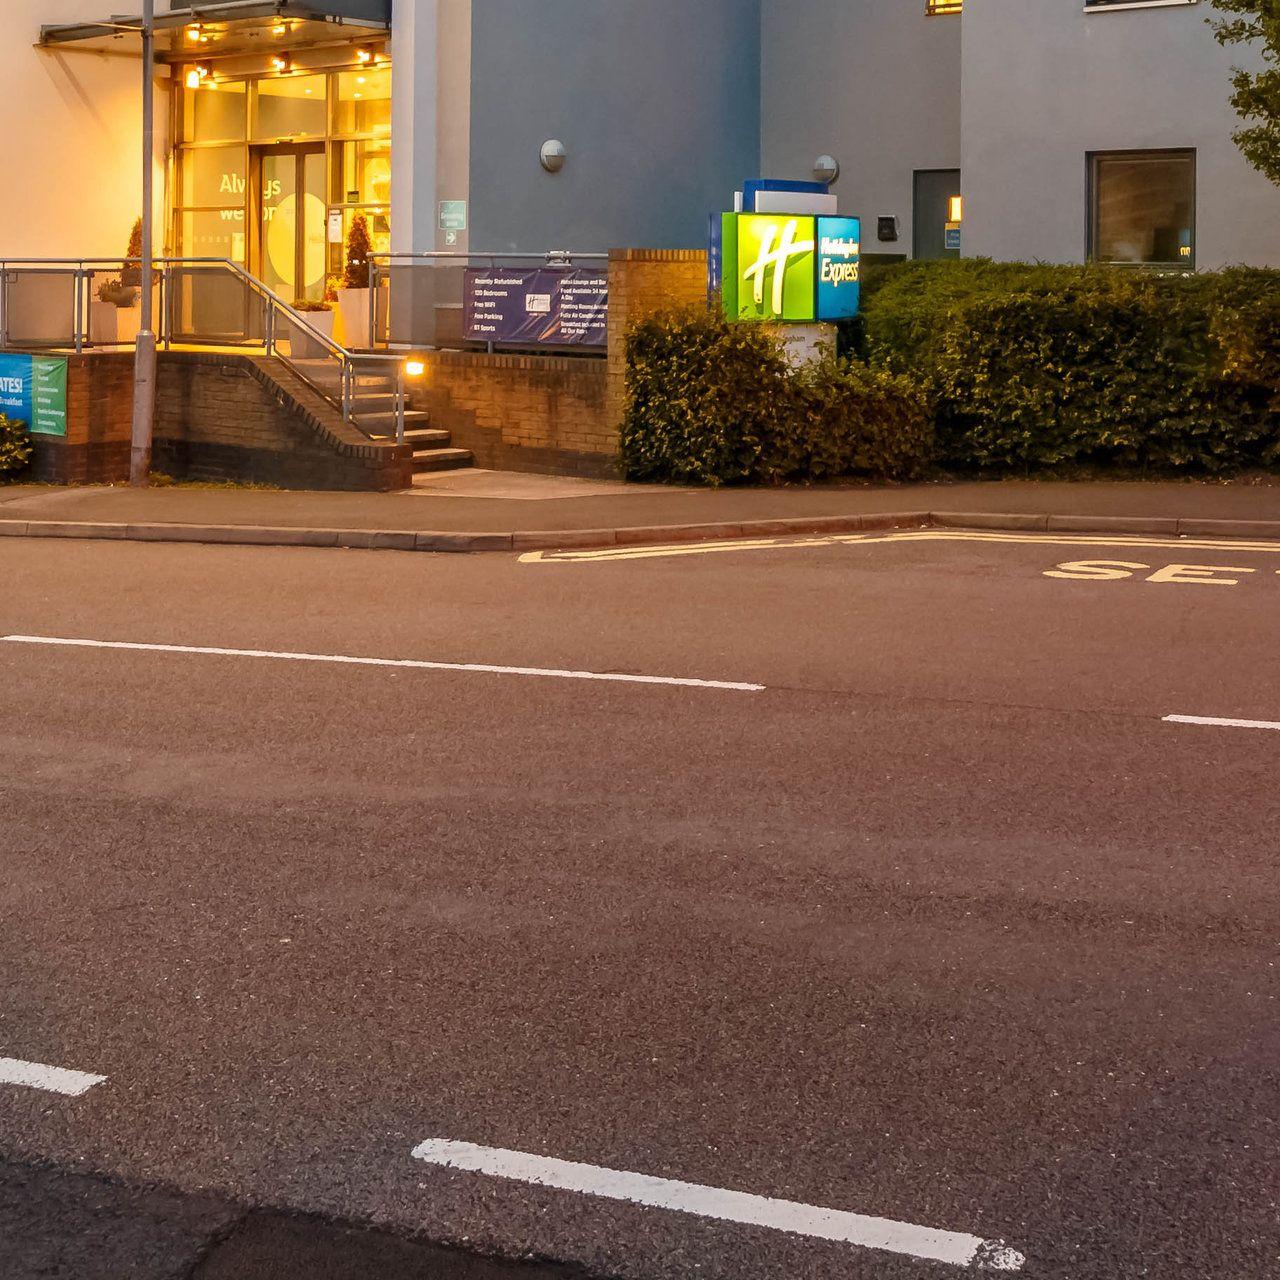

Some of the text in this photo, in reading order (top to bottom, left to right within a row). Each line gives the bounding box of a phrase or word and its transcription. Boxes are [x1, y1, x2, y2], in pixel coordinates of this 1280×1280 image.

[220, 173, 282, 199] Alys
[821, 258, 859, 287] Express
[484, 313, 503, 321] Parking
